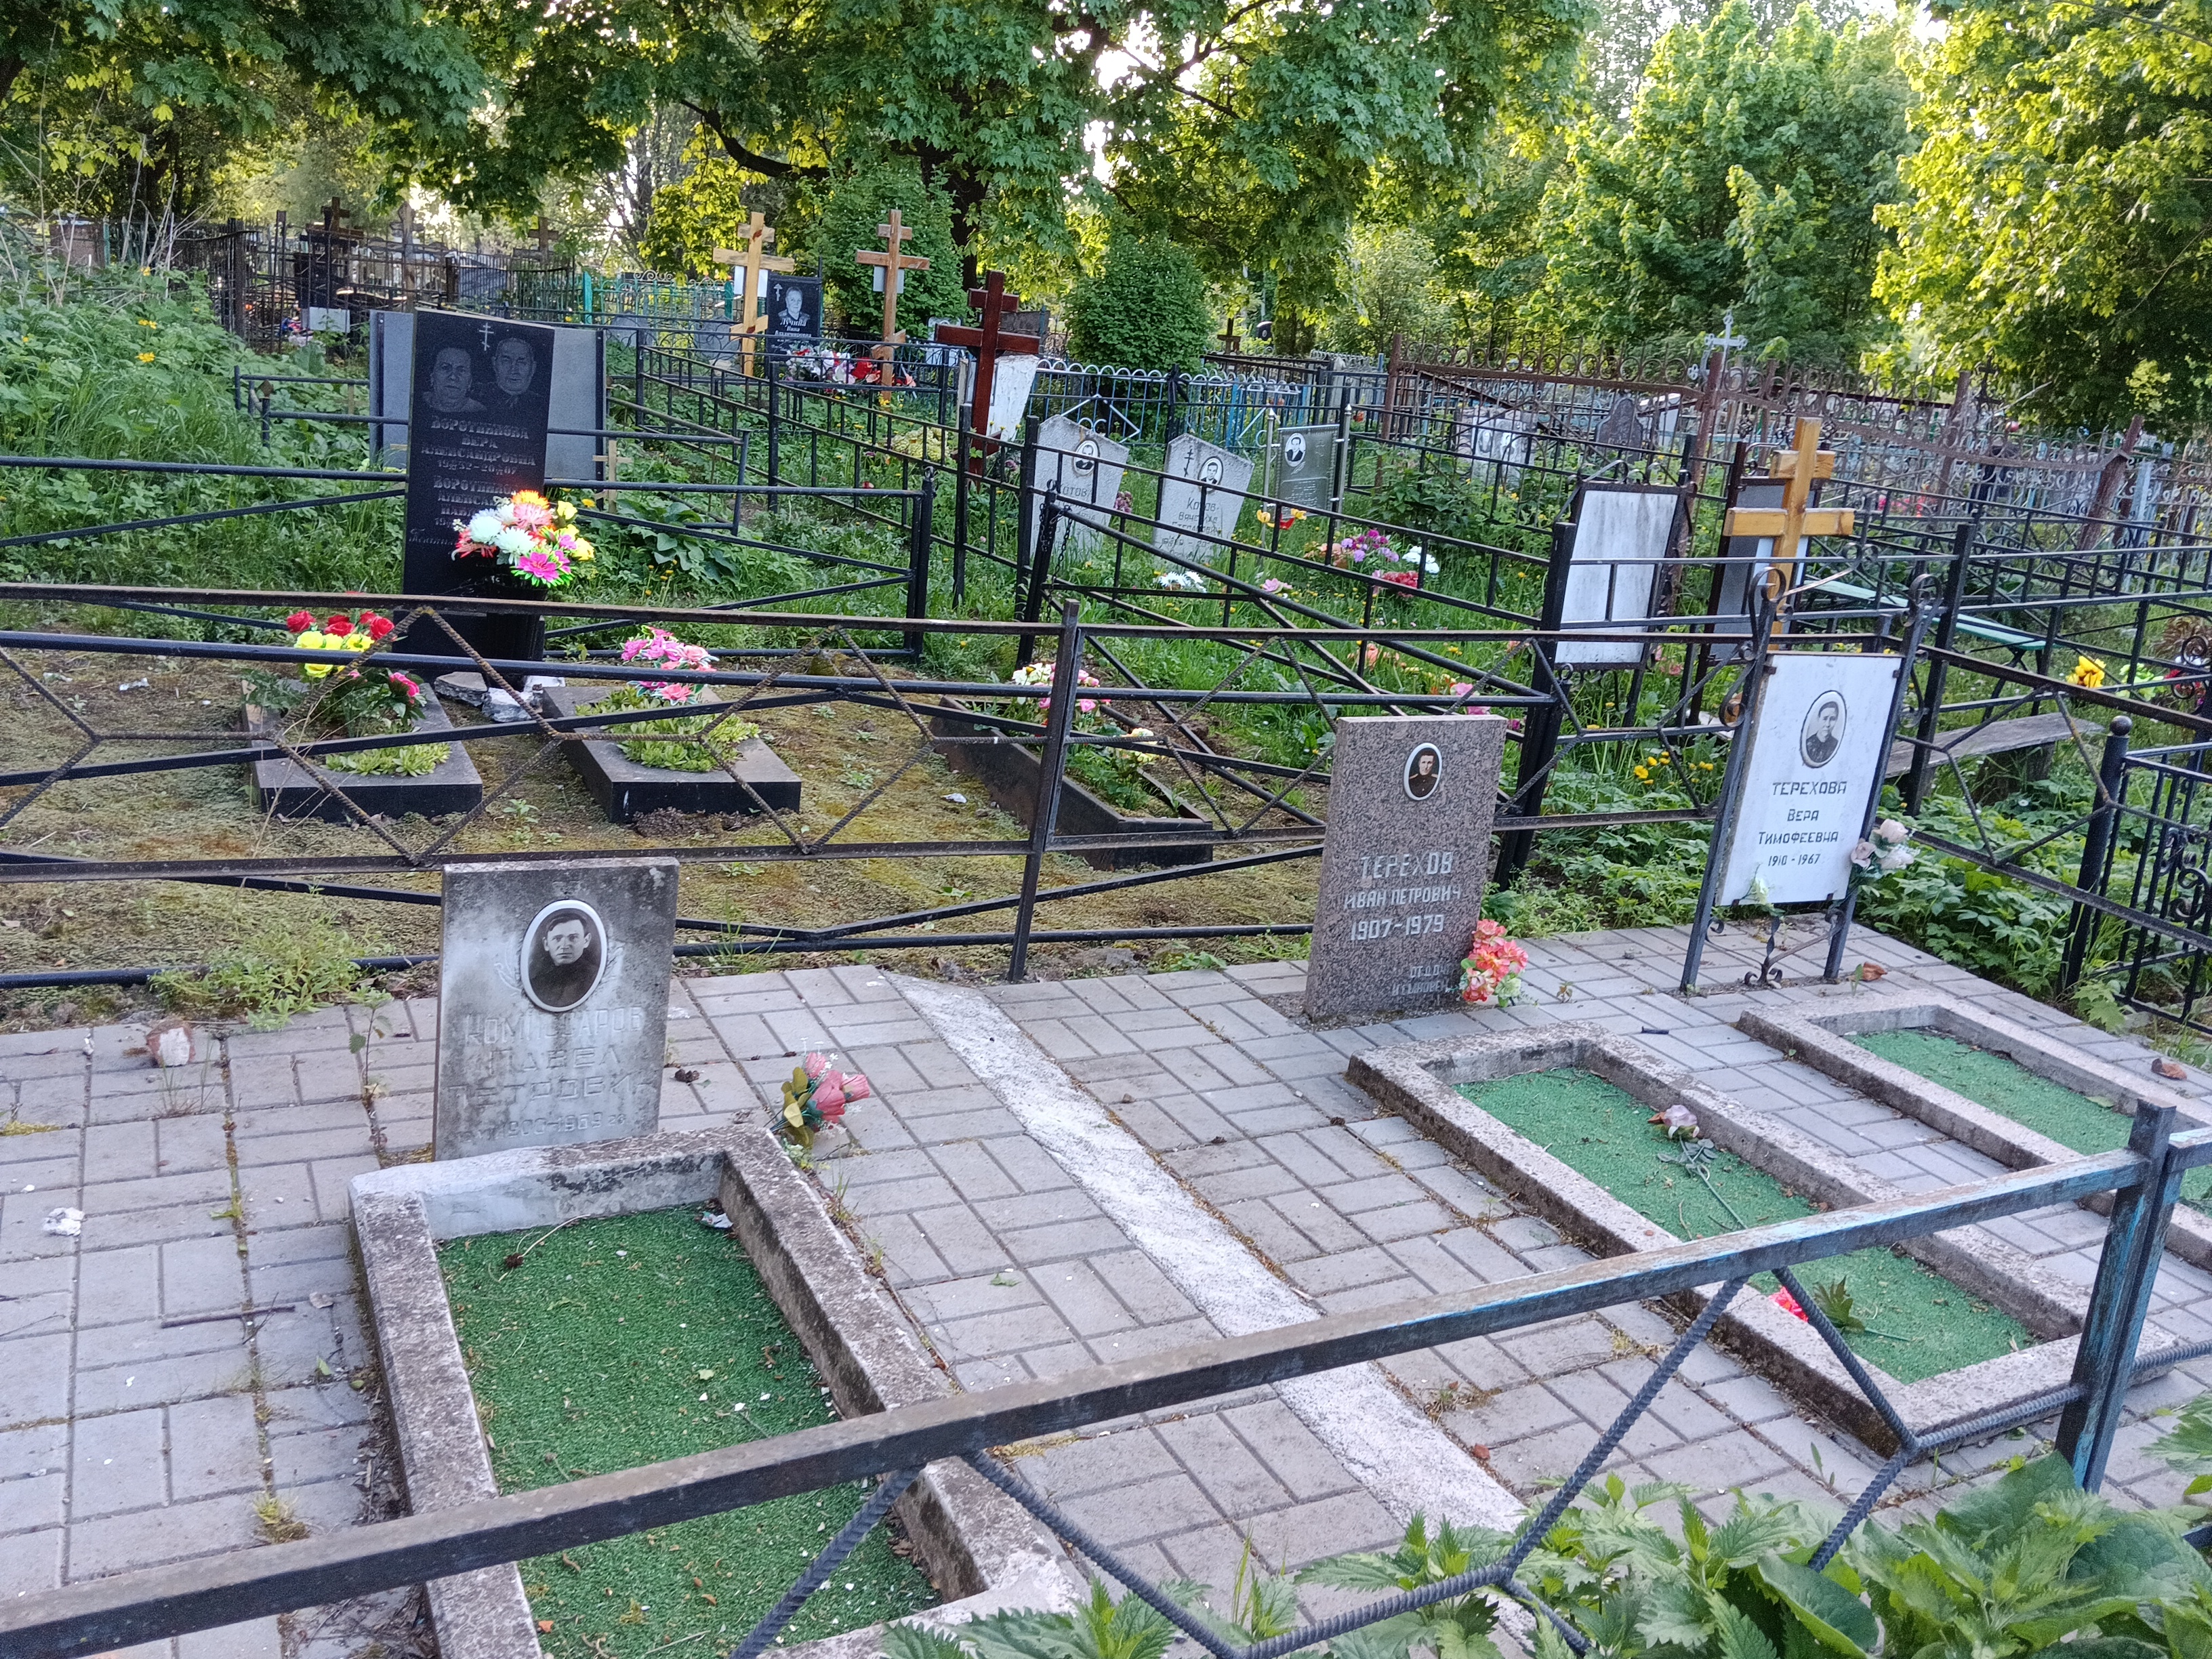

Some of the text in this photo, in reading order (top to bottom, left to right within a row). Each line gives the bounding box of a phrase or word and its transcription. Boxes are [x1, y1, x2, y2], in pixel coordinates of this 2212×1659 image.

[1187, 497, 1216, 512] КООВ
[1773, 781, 1847, 796] ТЕРЕХОВА
[1787, 808, 1820, 821] ВЕРА
[1759, 831, 1839, 845] ТИМОФЕЕВНА
[1360, 851, 1453, 879] ТЕРЕХОВ
[1768, 855, 1788, 867] 1910
[1798, 853, 1821, 865] 1967
[1344, 885, 1462, 909] ИВАН ПЕТРОВИЧ
[1351, 915, 1445, 941] 1907-1979
